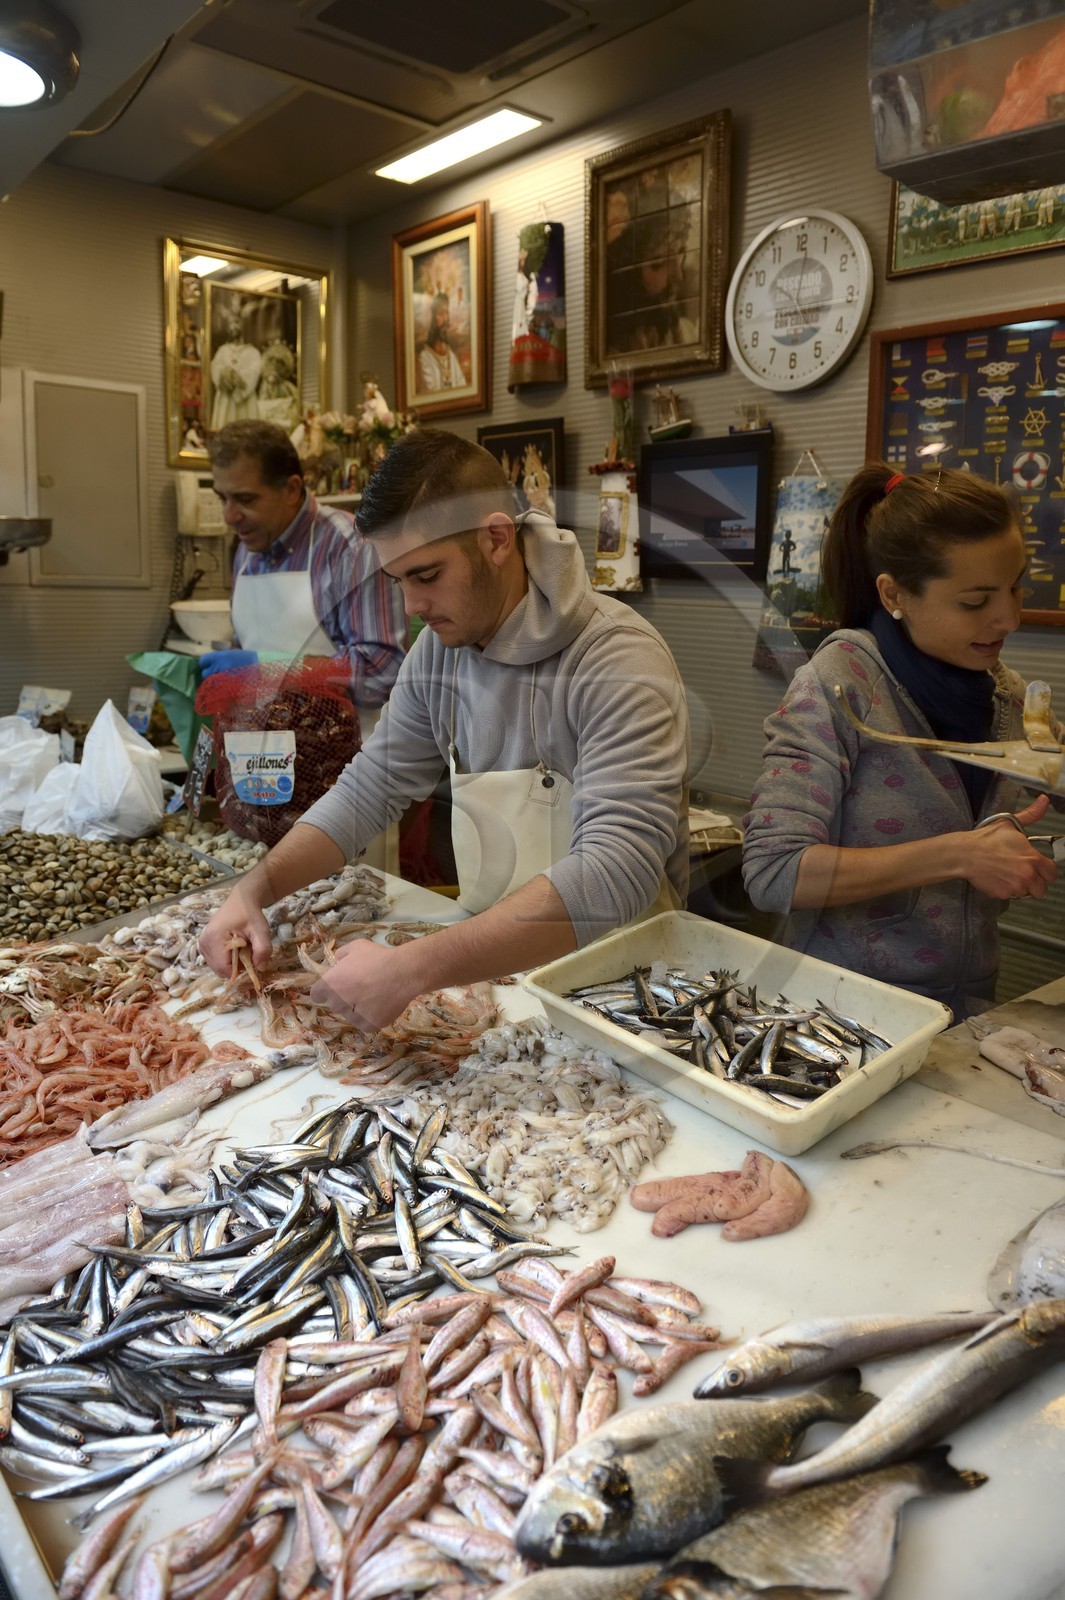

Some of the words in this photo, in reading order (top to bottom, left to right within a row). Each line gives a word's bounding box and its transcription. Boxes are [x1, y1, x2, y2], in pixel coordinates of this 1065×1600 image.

[796, 233, 807, 251] 12
[822, 236, 828, 254] 1
[772, 247, 782, 264] 11
[839, 254, 849, 272] 2
[755, 270, 766, 287] 10
[846, 285, 855, 304] 3
[745, 302, 753, 319] 9
[835, 316, 844, 334] 4
[751, 331, 759, 348] 8
[769, 348, 777, 365] 7
[814, 341, 822, 359] 5
[789, 352, 797, 370] 6
